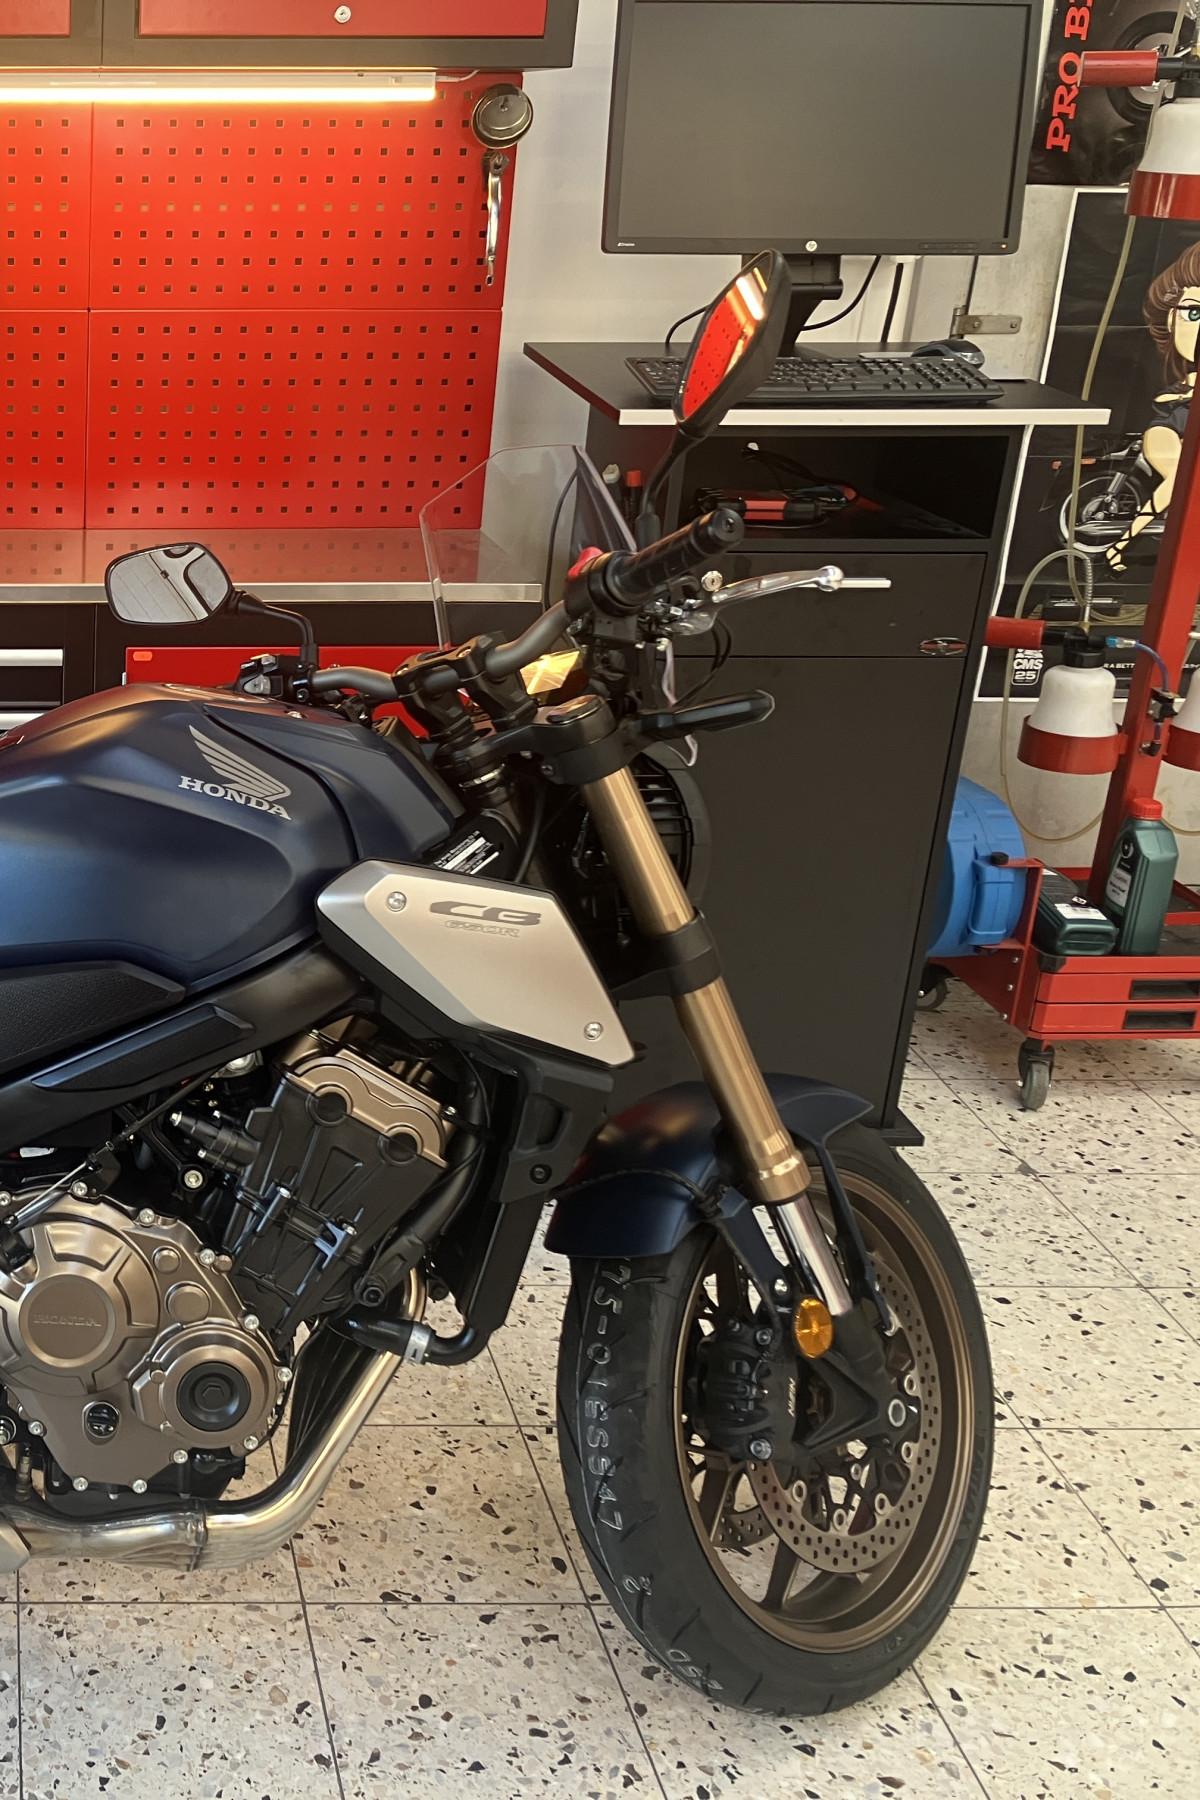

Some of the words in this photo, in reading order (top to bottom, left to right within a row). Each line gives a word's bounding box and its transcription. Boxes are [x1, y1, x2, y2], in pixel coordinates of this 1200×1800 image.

[1046, 52, 1081, 152] PRO
[1065, 0, 1093, 40] B
[1014, 659, 1043, 670] CMS
[1015, 671, 1036, 680] 25
[178, 775, 292, 820] HONDA
[430, 901, 541, 926] CB
